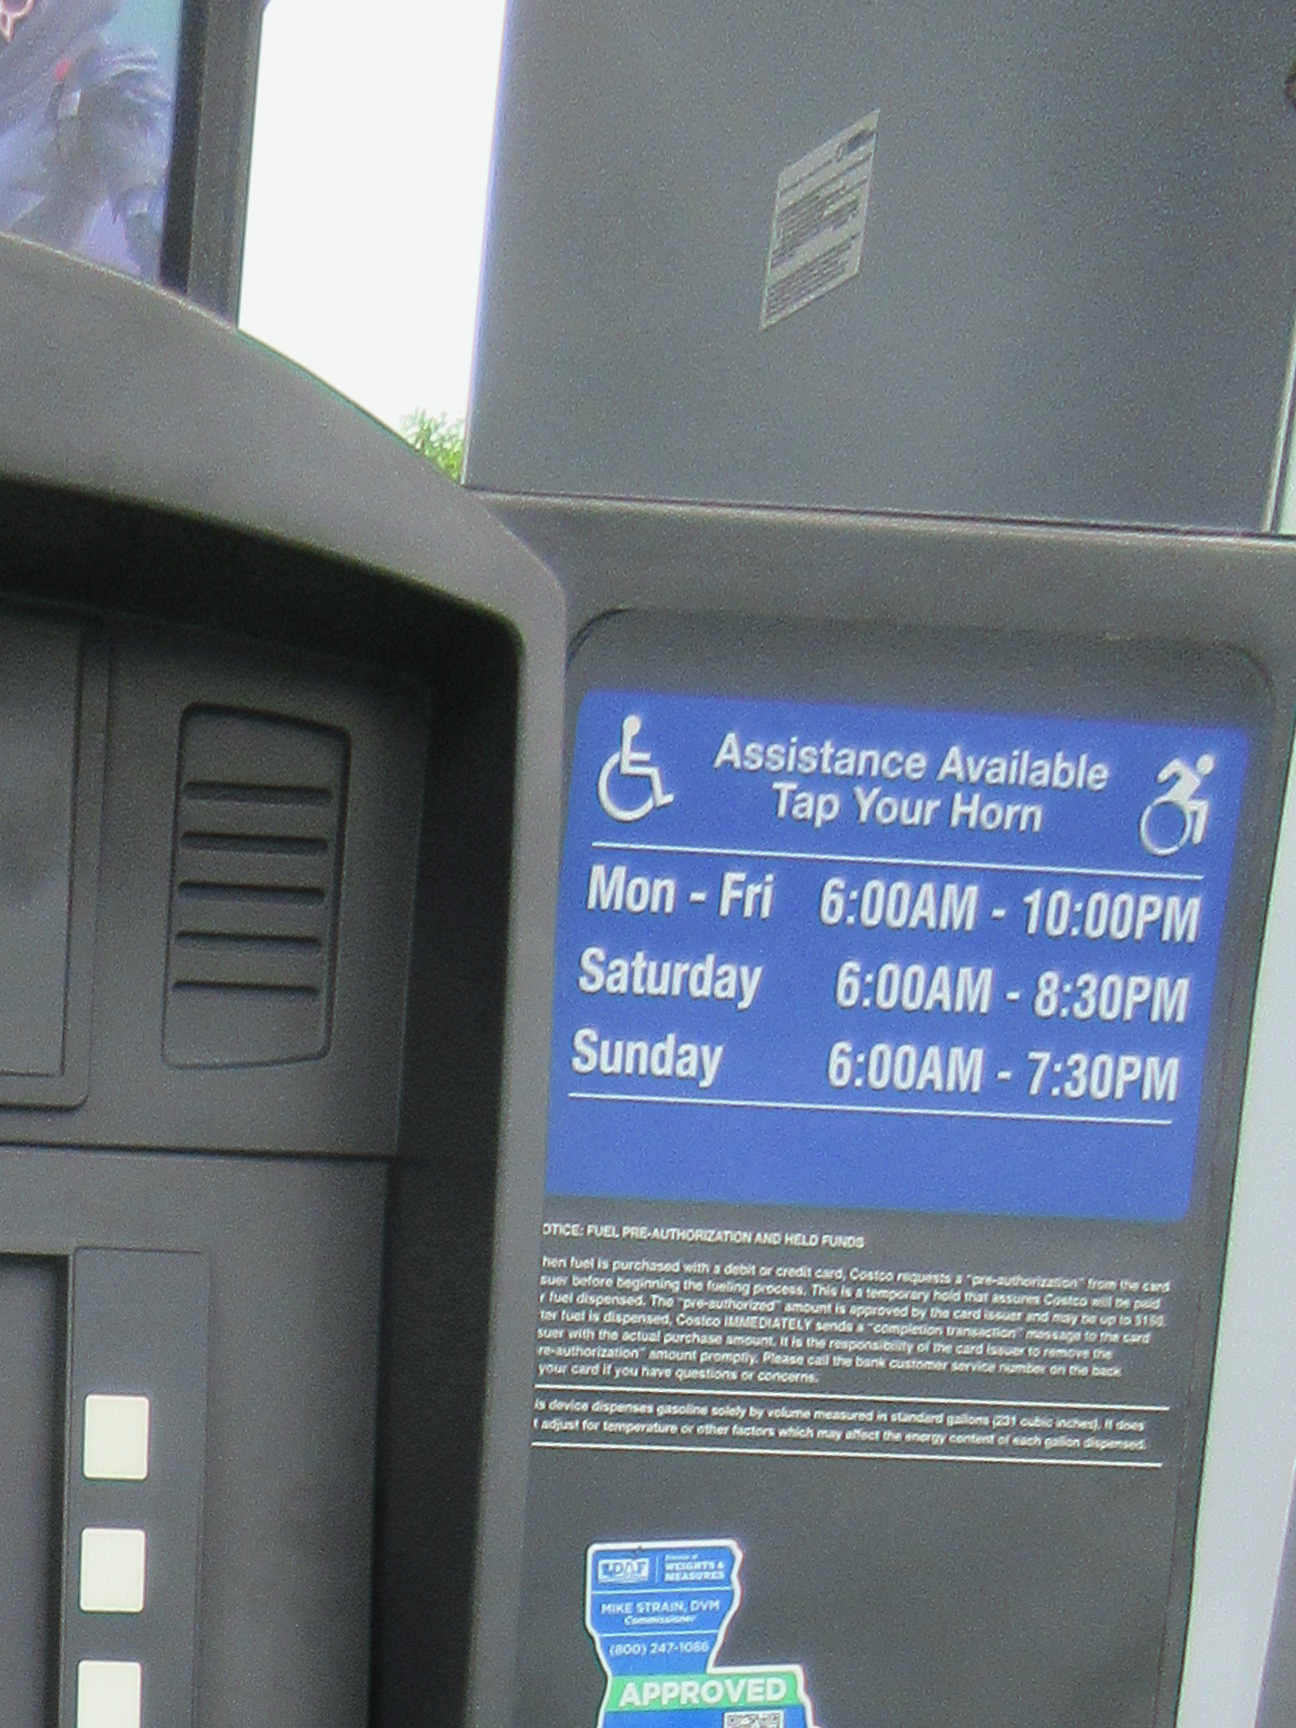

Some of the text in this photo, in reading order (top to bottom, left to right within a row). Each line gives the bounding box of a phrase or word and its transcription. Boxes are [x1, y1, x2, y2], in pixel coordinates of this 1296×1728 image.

[714, 731, 1111, 791] Assistance Available
[771, 780, 1044, 832] Tap Your Horn
[587, 863, 677, 914] Mon
[719, 870, 775, 919] Fri
[821, 877, 979, 930] 6:00AM
[1024, 889, 1202, 942] 10:00PM
[579, 947, 763, 1009] Saturday
[837, 961, 994, 1013] 6:00AM
[1035, 971, 1190, 1022] 8:30PM
[572, 1028, 723, 1087] Sunday
[829, 1041, 984, 1092] 6:00AM
[1029, 1052, 1181, 1101] 7:30PM
[619, 1677, 788, 1707] APPROVED
